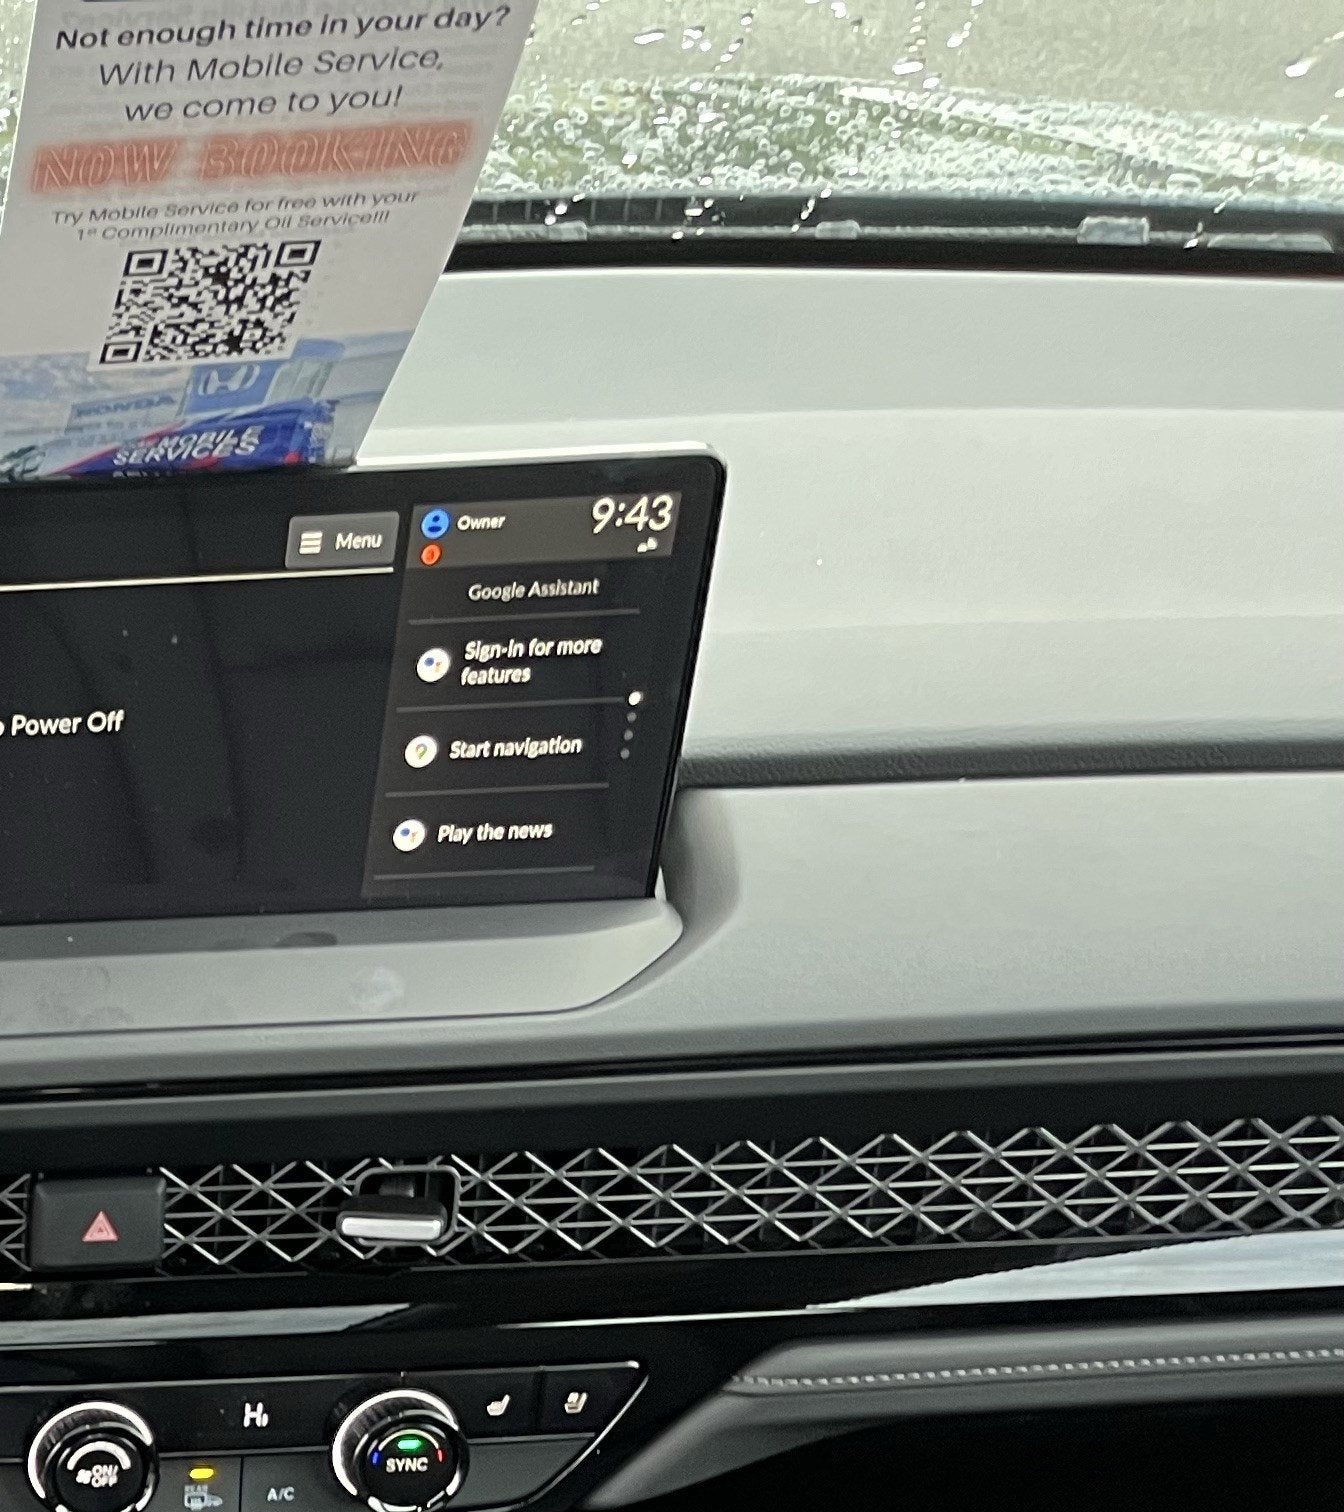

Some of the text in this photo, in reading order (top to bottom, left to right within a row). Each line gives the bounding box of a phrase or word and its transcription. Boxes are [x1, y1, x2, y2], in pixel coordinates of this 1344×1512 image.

[56, 4, 511, 50] Not enough time in your day?
[100, 47, 444, 86] With Mobile Service,
[125, 85, 403, 122] we come to you!
[32, 124, 470, 193] NOW BOOKING
[53, 190, 418, 226] Try Mobile Service for free with your
[102, 217, 259, 240] Complimentary
[264, 216, 292, 231] Oil
[155, 425, 263, 449] MOBILE
[113, 437, 261, 466] SERVICES
[457, 514, 506, 532] Owner
[592, 494, 674, 535] 9:43
[335, 530, 383, 552] Menu
[468, 578, 600, 602] Google Assistant
[528, 637, 553, 657] for
[556, 638, 603, 655] more
[461, 665, 531, 686] features
[11, 714, 82, 737] Power
[87, 710, 125, 734] Off
[449, 735, 583, 760] Start navigation
[437, 822, 553, 845] Play the news
[386, 1457, 429, 1474] SYNC
[91, 1475, 118, 1488] OFF
[267, 1486, 296, 1503] A/C
